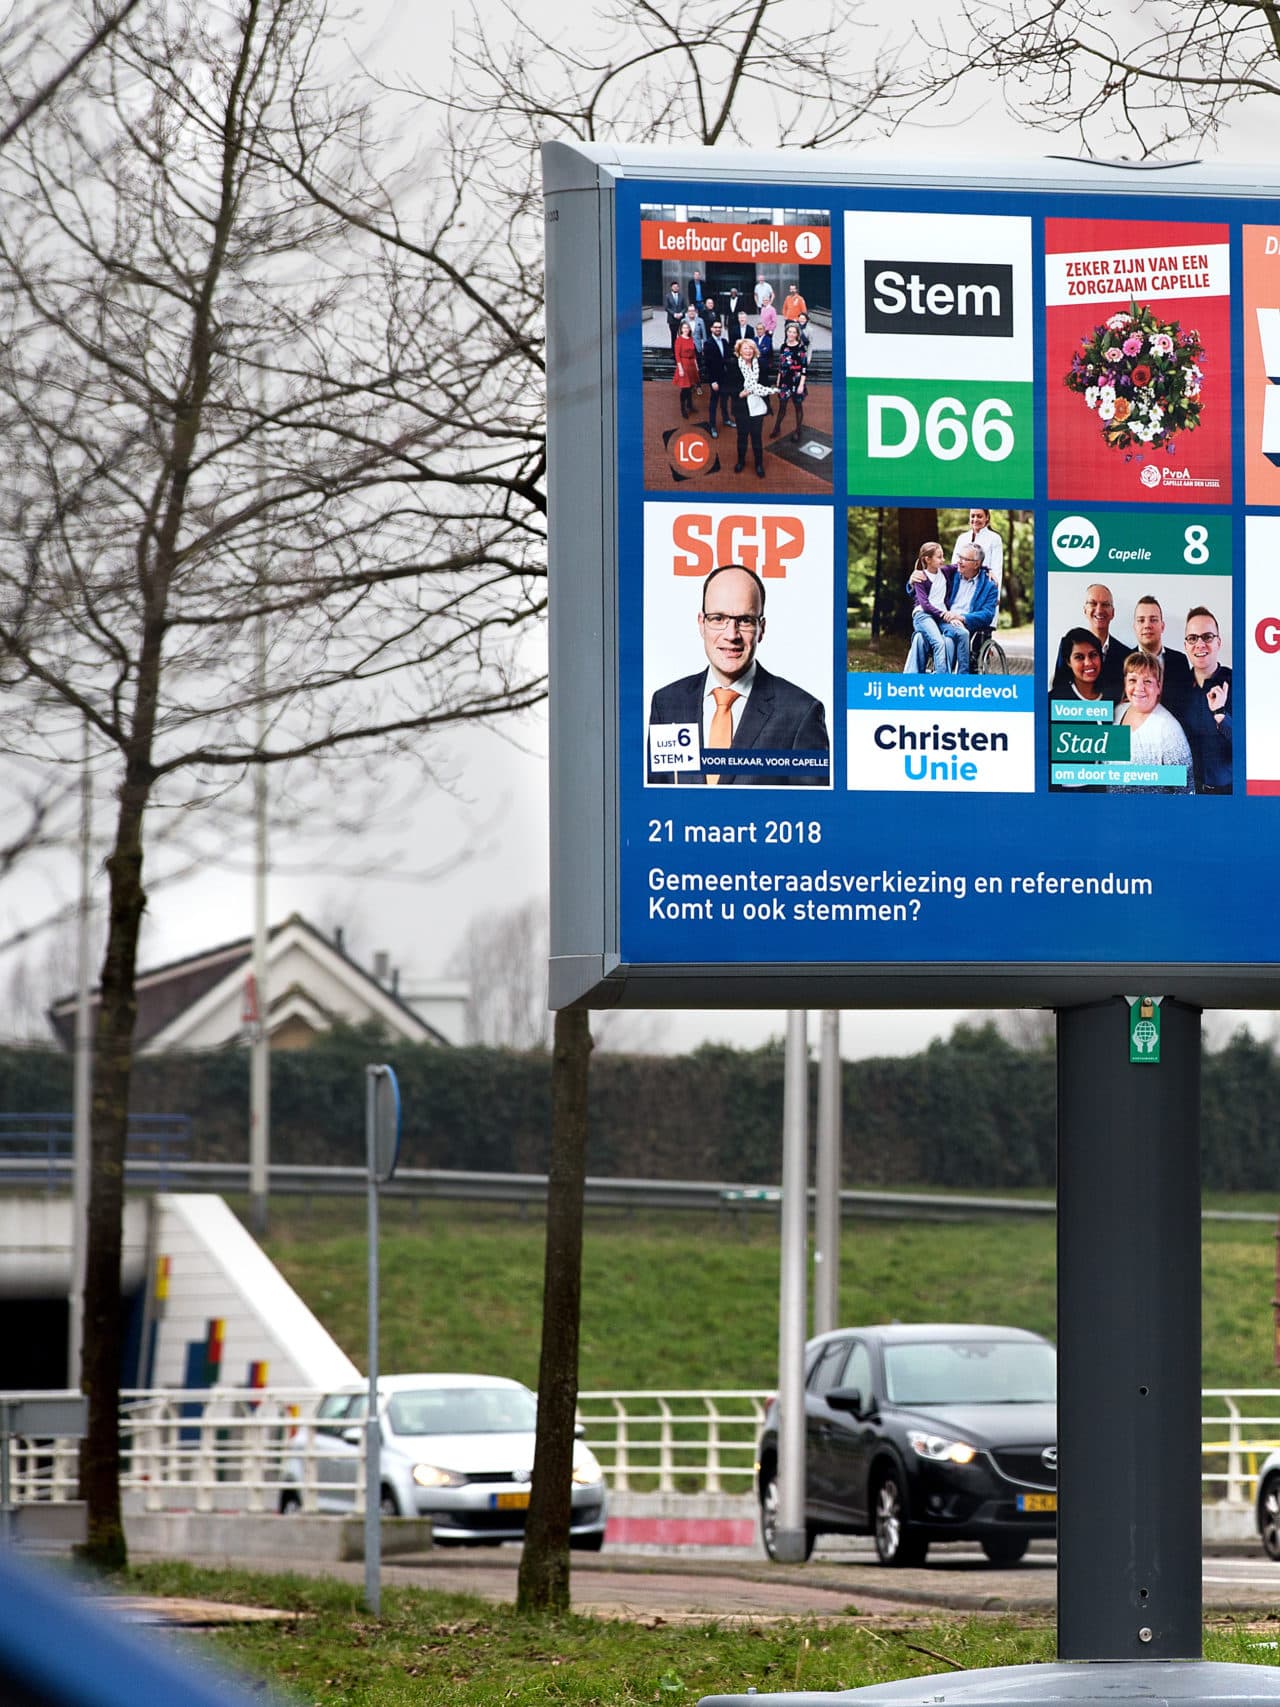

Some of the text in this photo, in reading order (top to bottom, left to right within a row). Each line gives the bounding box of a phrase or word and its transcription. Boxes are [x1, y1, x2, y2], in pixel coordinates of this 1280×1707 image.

[658, 228, 813, 257] Leefbaar Capelle 1
[1065, 254, 1209, 278] ZEKER ZIJN VAN EEN
[872, 270, 1001, 316] Stem
[1068, 273, 1210, 296] ZORGZAAM CAPELLE
[866, 393, 1015, 462] D66
[679, 441, 704, 463] LC
[672, 514, 805, 578] SGP
[1056, 534, 1095, 549] CDA
[1108, 524, 1210, 565] Capelle 8
[864, 681, 1018, 700] Jij bent waardevol
[1055, 704, 1108, 717] Voor een
[657, 728, 691, 748] LIJST 6
[874, 723, 1009, 752] Christen
[1057, 731, 1109, 754] Stad
[654, 754, 683, 764] STEM
[702, 756, 829, 767] VOOR ELKAAR, VOOR CAPELLE
[904, 754, 978, 781] Unie
[1055, 768, 1159, 783] om door te geven
[648, 820, 822, 844] 21 maart 2018
[648, 868, 1153, 898] Gemeenteraadsverkiezing en referendum
[649, 898, 922, 921] Komt u ook stemmen?
